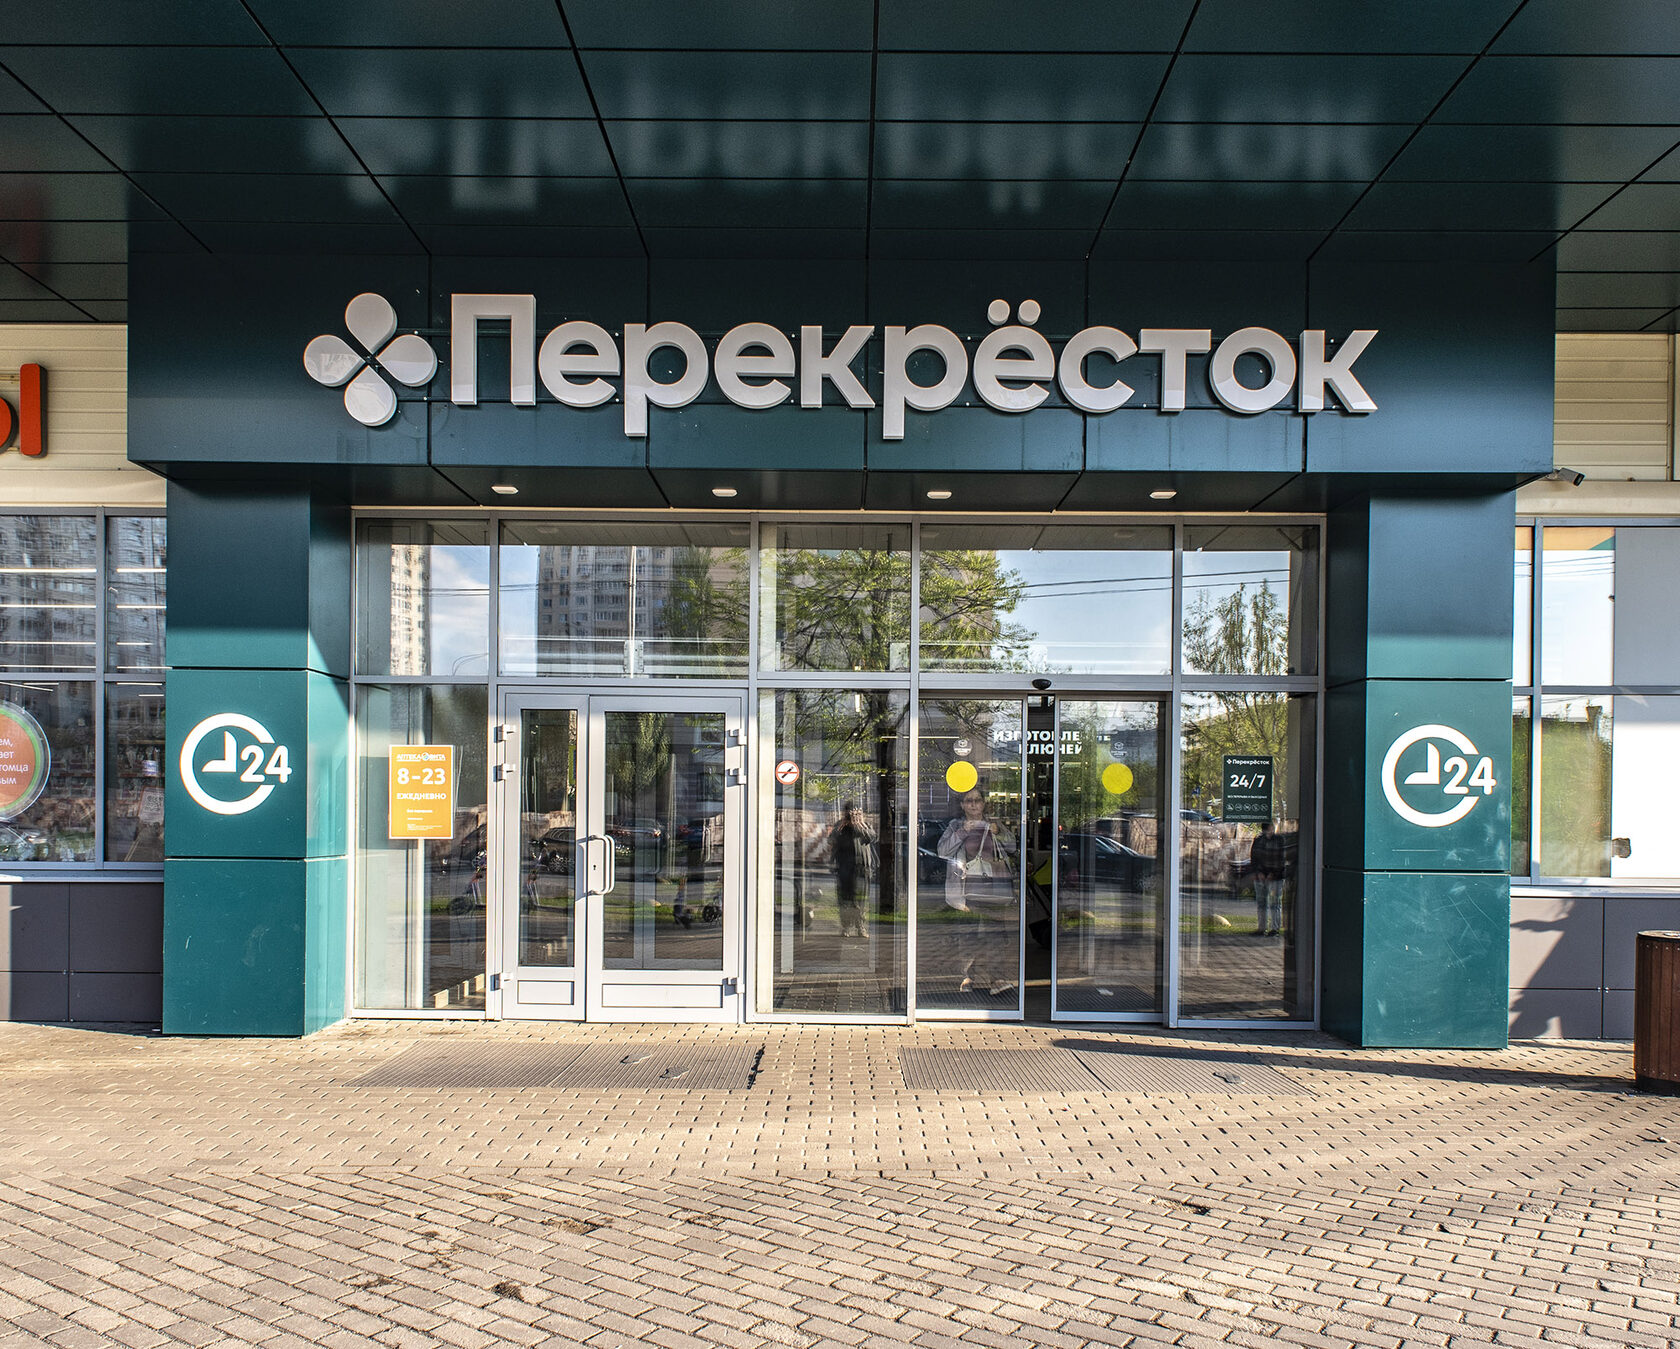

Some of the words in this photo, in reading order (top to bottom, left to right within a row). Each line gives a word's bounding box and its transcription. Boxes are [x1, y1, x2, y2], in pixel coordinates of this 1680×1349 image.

[451, 293, 1378, 440] Перекрёсток
[240, 744, 292, 783] 24
[1230, 773, 1265, 789] 24/7
[1443, 756, 1497, 795] 24
[396, 792, 447, 800] ЕЖЕДНЕВНО
